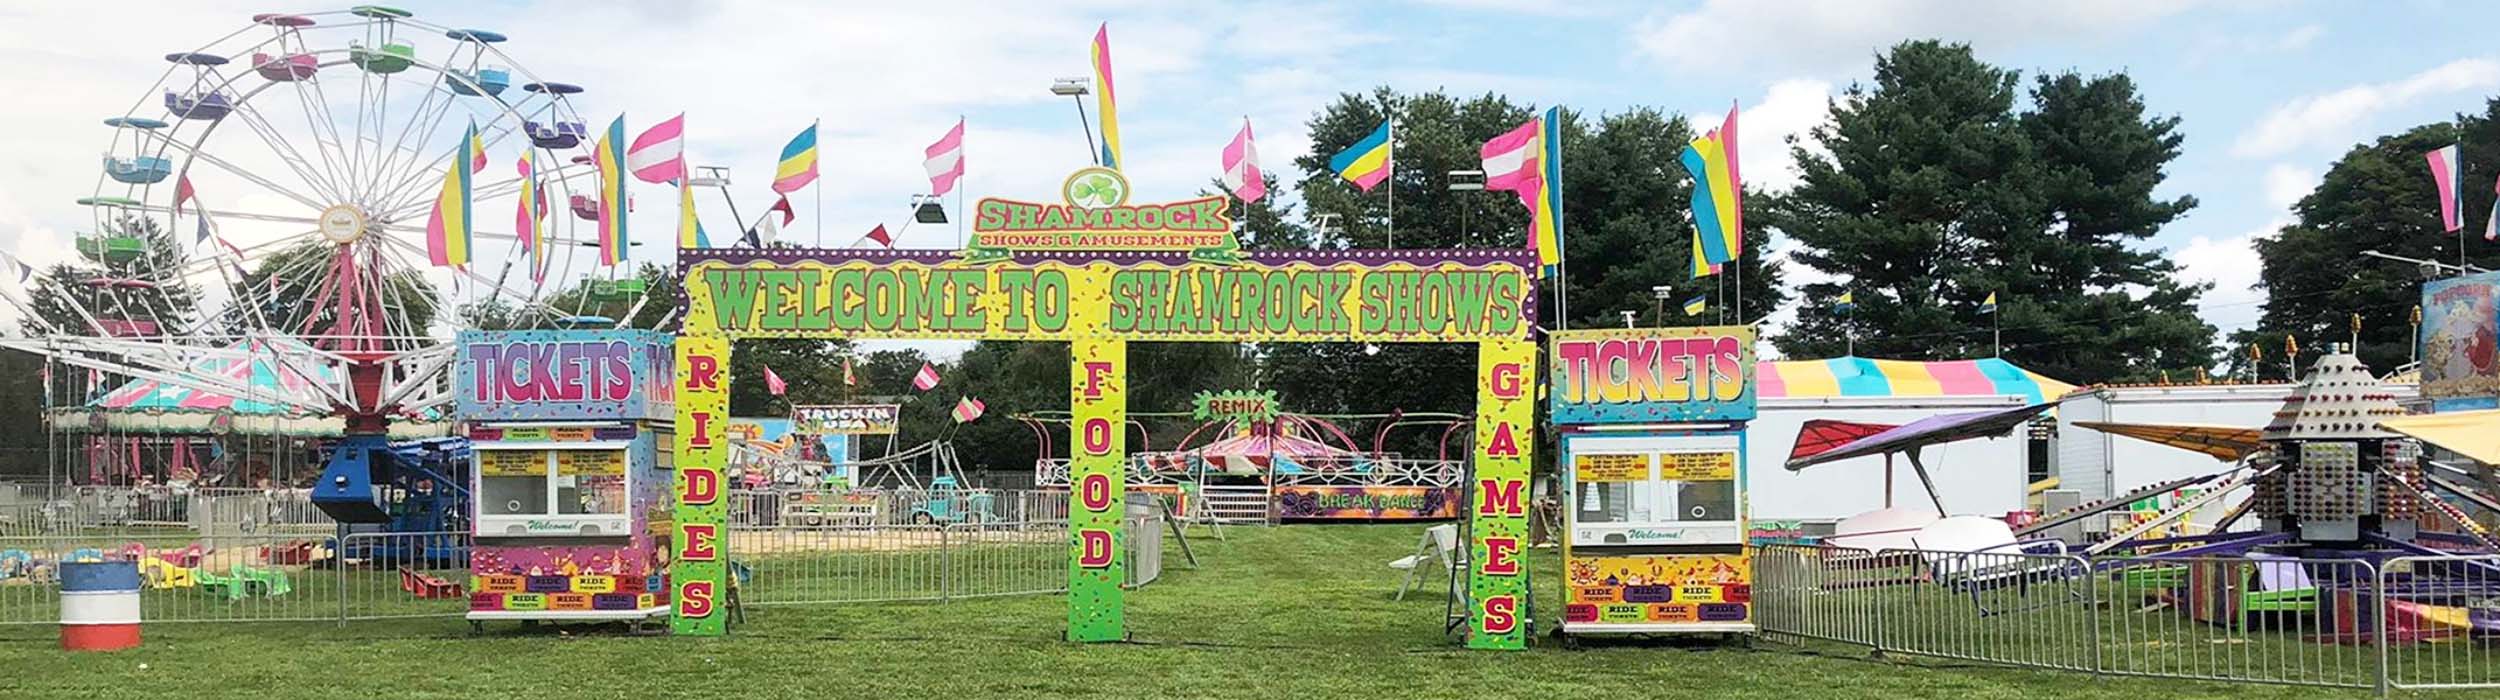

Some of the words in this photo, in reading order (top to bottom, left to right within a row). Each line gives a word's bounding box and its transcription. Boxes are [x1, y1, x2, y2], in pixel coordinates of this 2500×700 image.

[977, 197, 1229, 231] SHAMROCK
[980, 235, 1051, 246] SHOWS
[1077, 235, 1223, 246] AMUSEMENTS
[704, 269, 987, 331] WELCOME
[1003, 269, 1070, 332] TO
[1110, 270, 1352, 334] SHAMROCK
[1359, 270, 1521, 334] SHOWS
[469, 340, 632, 403] TICKETS
[1558, 337, 1744, 404] TICKETS
[799, 407, 891, 420] TRUCKIN
[823, 419, 867, 429] USA
[1208, 399, 1266, 414] REMIX
[680, 354, 718, 618] RIDES
[1079, 361, 1113, 568] FOOD
[1318, 493, 1375, 508] BREAK
[1379, 493, 1425, 508] DANCE
[1480, 362, 1523, 633] GAMES
[1628, 529, 1684, 540] Welcome!
